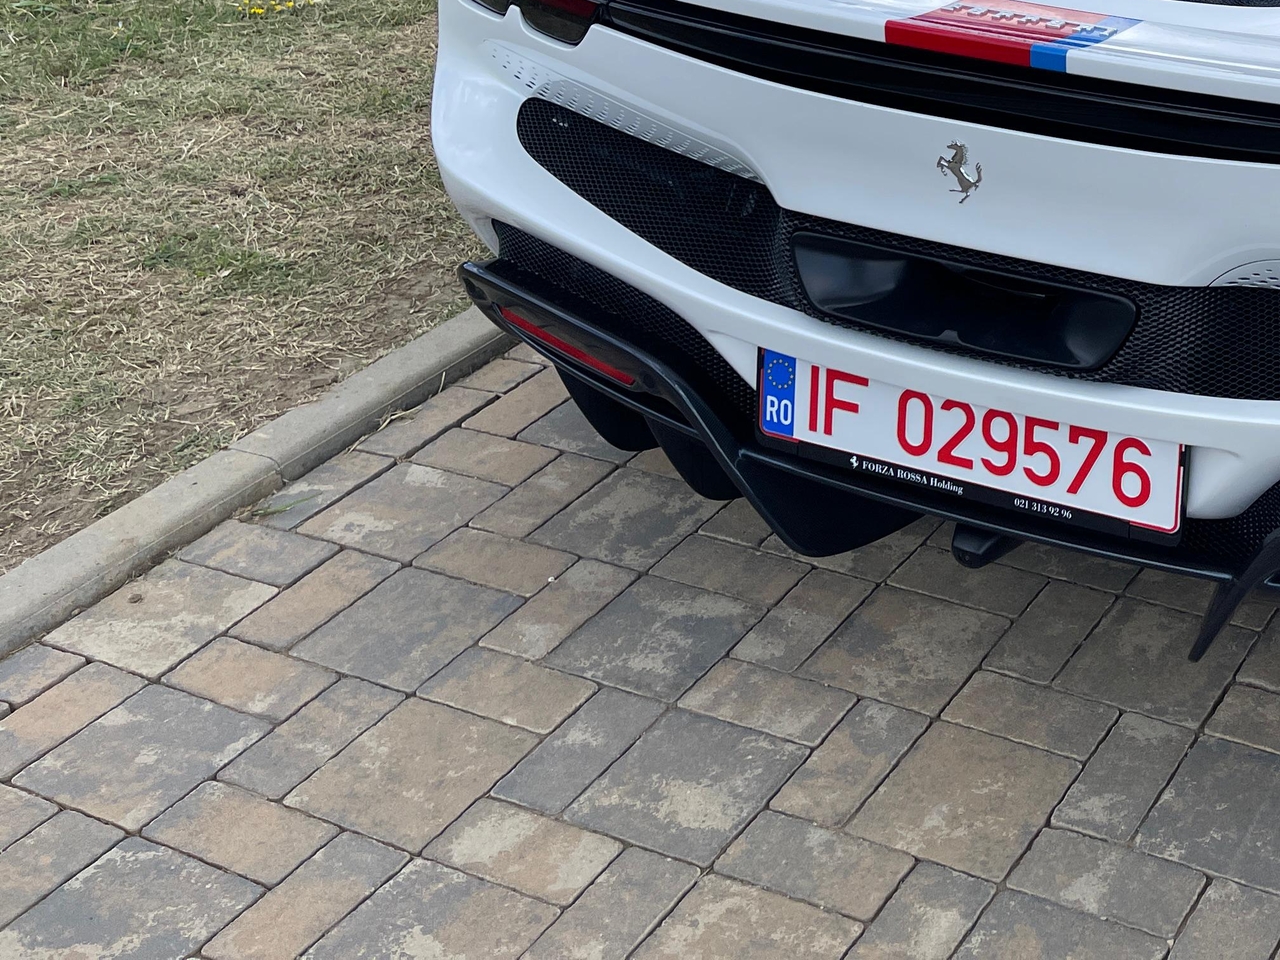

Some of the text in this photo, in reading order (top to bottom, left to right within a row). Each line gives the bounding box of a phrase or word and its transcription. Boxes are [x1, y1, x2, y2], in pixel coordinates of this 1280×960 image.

[766, 395, 792, 426] RO
[808, 365, 1152, 508] IF 029576
[862, 460, 964, 495] FORZA ROSSA Holding
[1014, 498, 1072, 519] 021 313 92 96
